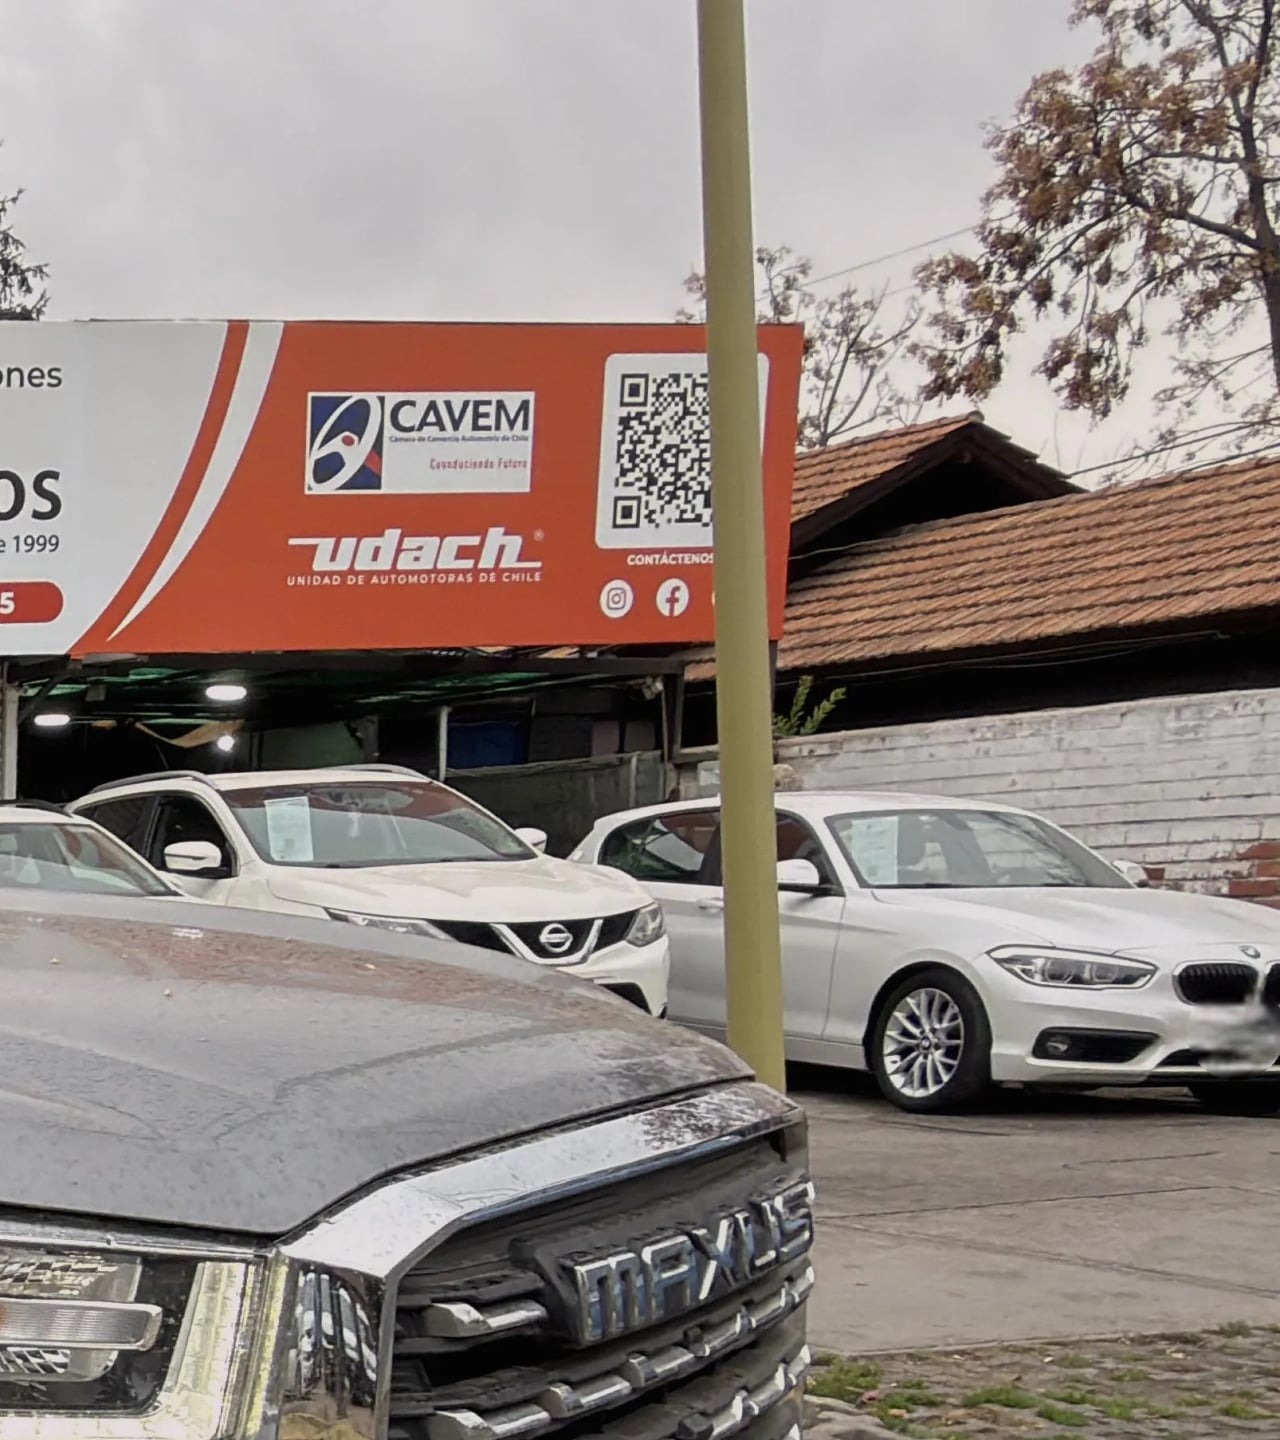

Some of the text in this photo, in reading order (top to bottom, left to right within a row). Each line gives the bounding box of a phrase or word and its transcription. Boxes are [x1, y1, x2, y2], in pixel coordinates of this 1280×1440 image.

[389, 399, 531, 433] CAVEM
[12, 534, 61, 554] 1999
[287, 526, 543, 572] udach
[286, 571, 542, 587] UNIDAD DE AUTOMOTORAS DE CHILE
